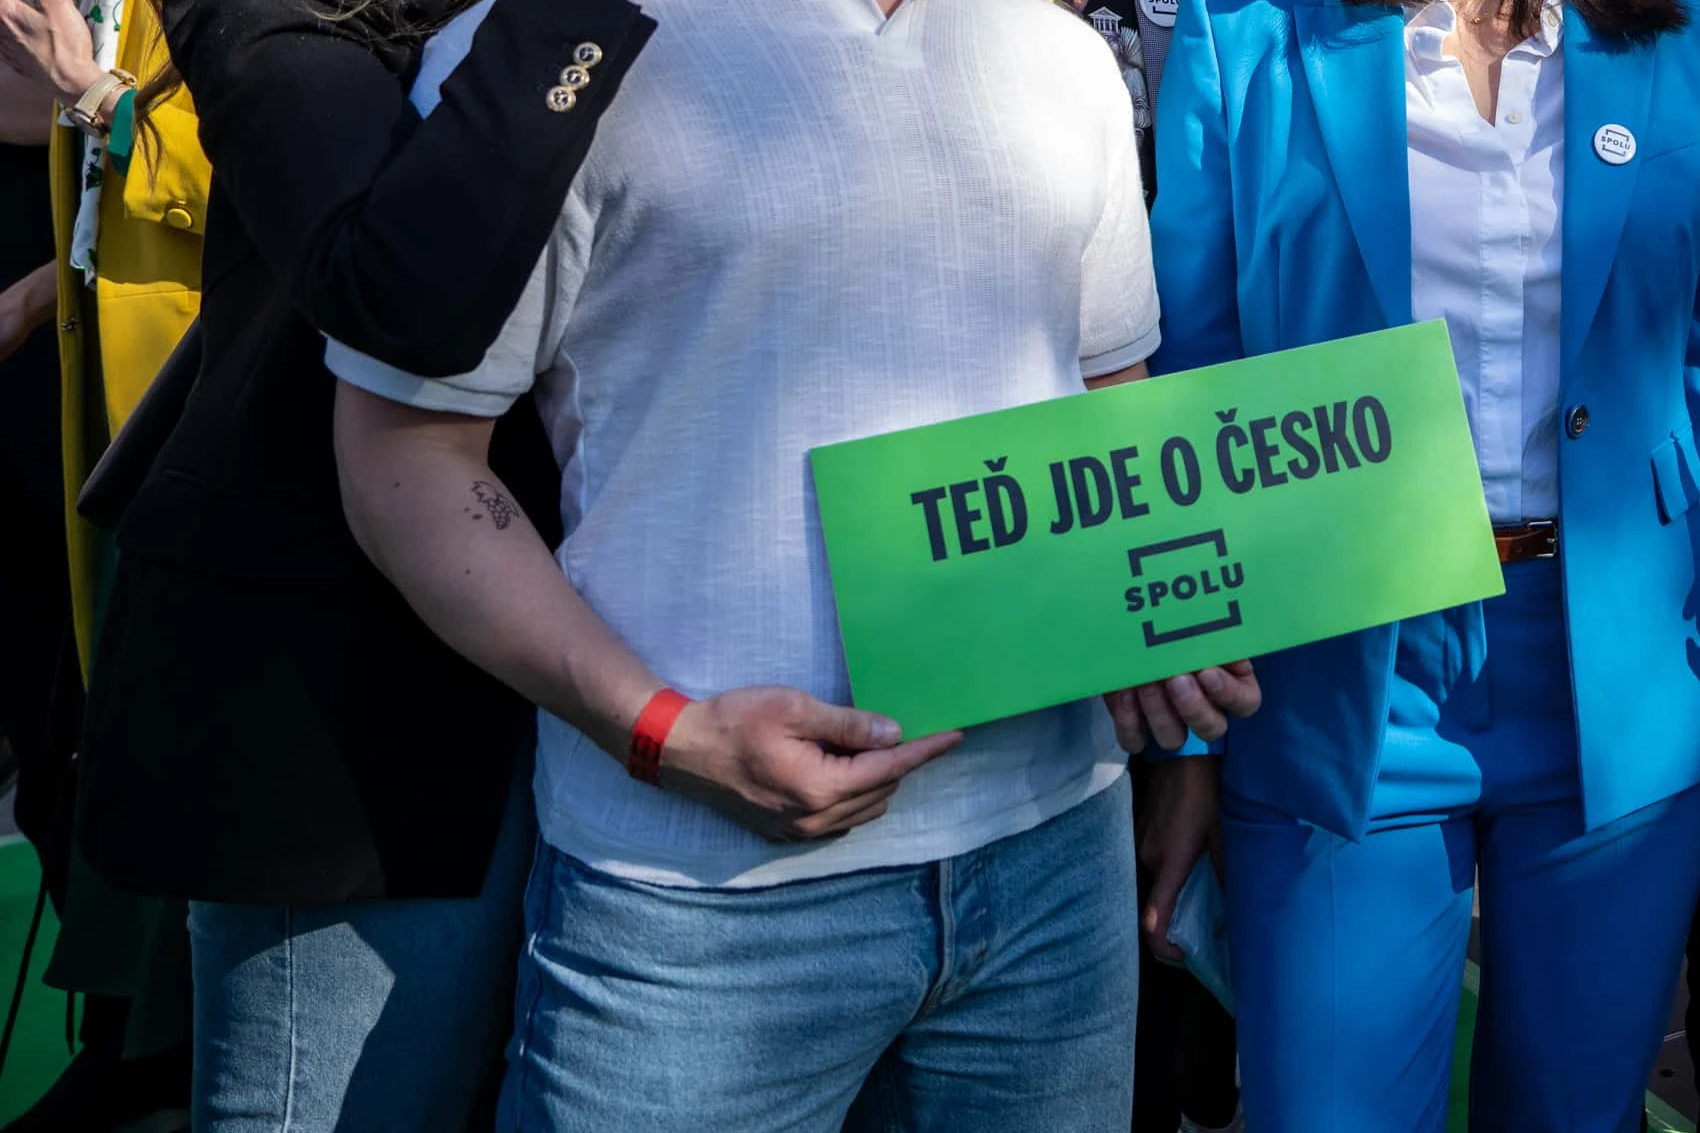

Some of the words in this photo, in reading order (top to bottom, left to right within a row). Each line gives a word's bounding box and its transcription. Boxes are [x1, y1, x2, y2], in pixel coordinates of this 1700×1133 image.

[1601, 136, 1631, 150] SPOLU
[911, 457, 1028, 562] TEĎ
[1049, 446, 1150, 535] JDE
[1161, 437, 1201, 506] O
[1215, 396, 1391, 494] ČESKO
[1125, 562, 1244, 612] SPOLU
